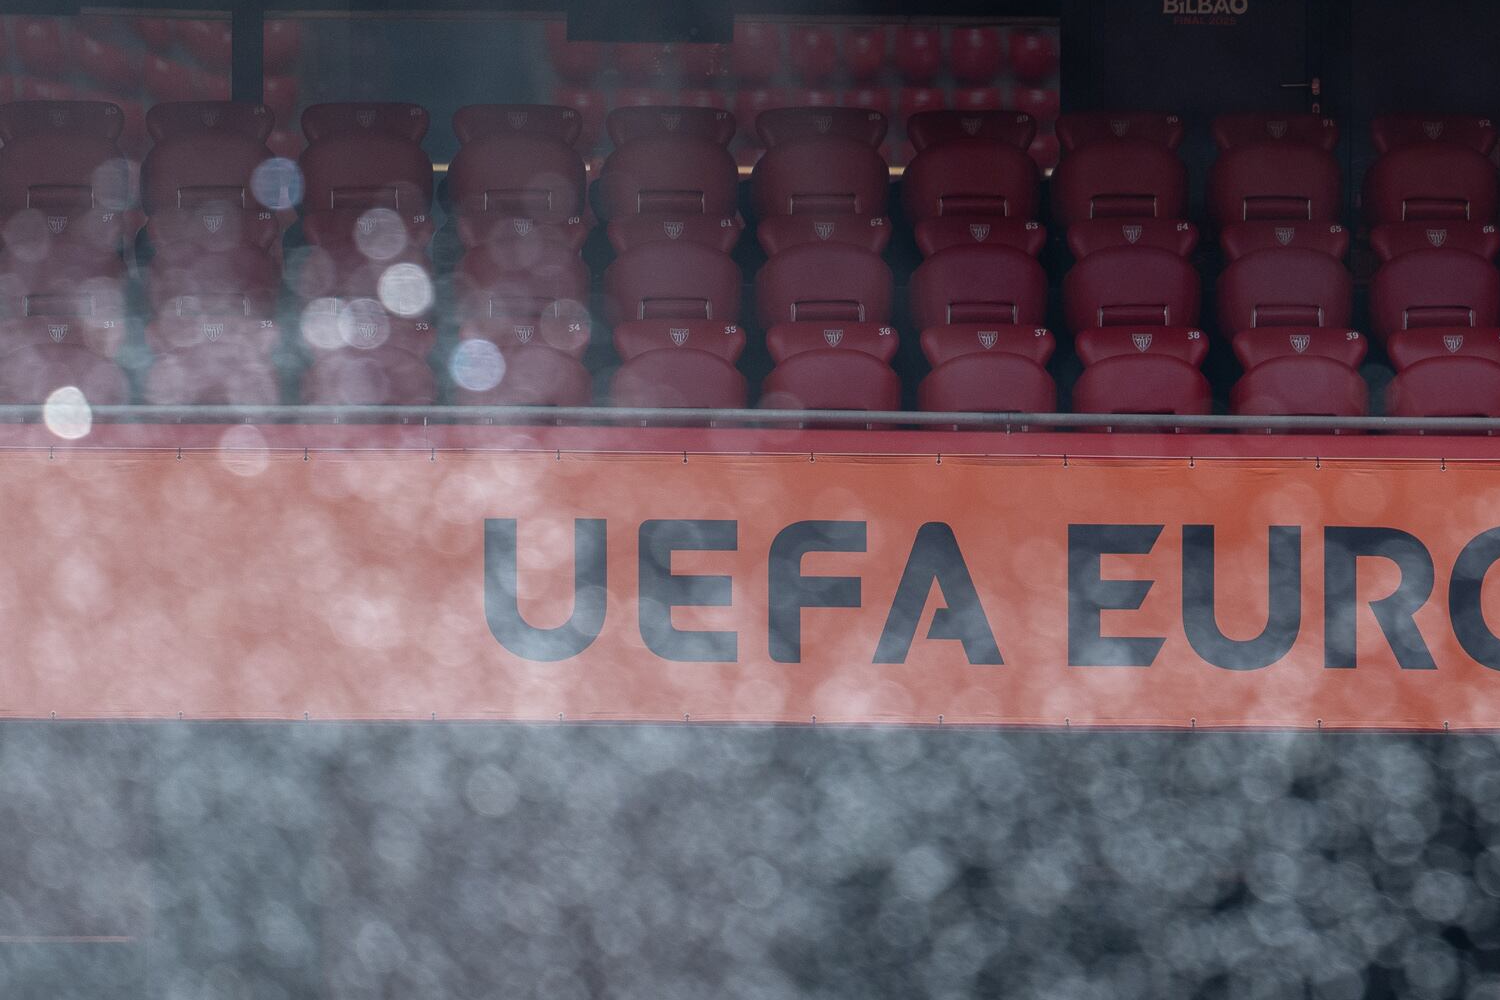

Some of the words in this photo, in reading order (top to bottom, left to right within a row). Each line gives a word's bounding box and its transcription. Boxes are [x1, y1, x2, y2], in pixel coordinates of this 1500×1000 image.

[1016, 114, 1029, 124] 89
[1166, 115, 1179, 124] 90
[1322, 119, 1334, 127] 91
[1478, 119, 1492, 128] 92
[413, 215, 425, 224] 59
[567, 216, 580, 225] 60
[720, 218, 732, 228] 61
[870, 217, 883, 227] 62
[1025, 222, 1039, 231] 63
[1176, 222, 1189, 232] 64
[1329, 225, 1342, 233] 65
[1482, 225, 1495, 234] 66
[103, 320, 115, 329] 31
[260, 320, 273, 329] 32
[415, 322, 429, 331] 33
[568, 323, 581, 333] 34
[724, 325, 737, 335] 35
[878, 327, 891, 336] 36
[1034, 328, 1047, 337] 37
[1187, 331, 1201, 340] 38
[1346, 331, 1359, 341] 39
[483, 517, 1004, 664] UEFA
